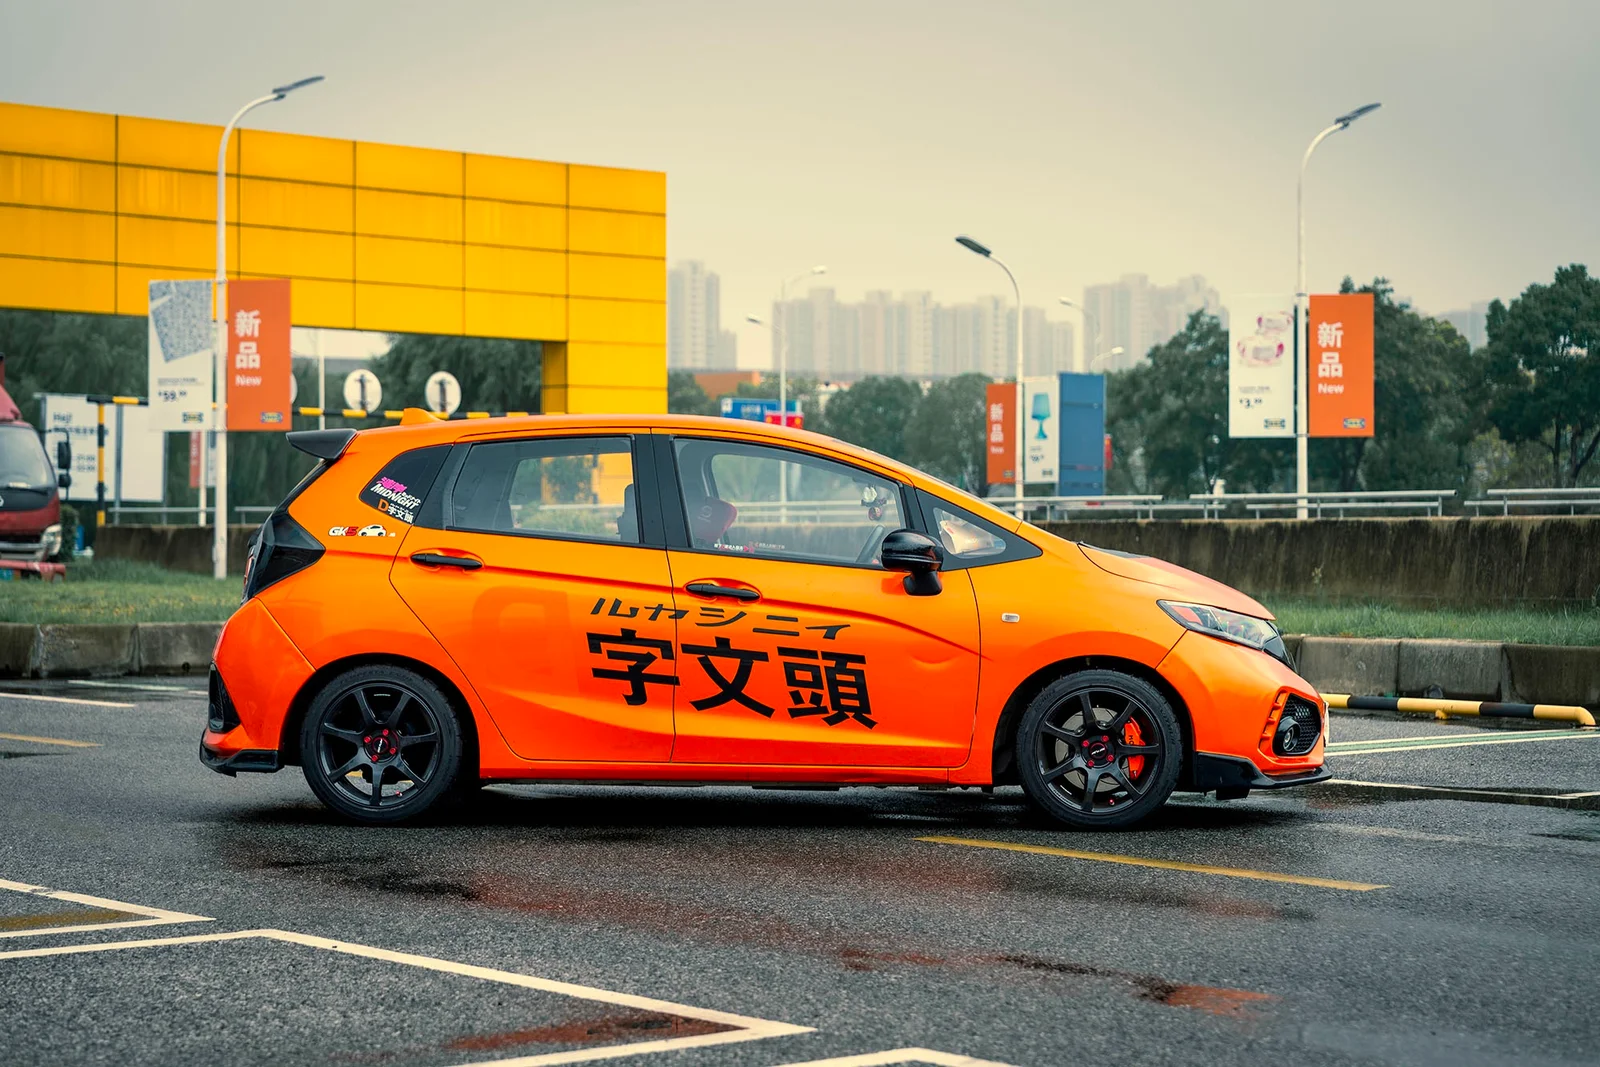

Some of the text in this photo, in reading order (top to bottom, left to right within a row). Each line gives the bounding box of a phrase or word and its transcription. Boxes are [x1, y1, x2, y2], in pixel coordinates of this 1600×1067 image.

[235, 309, 261, 369] 新品
[1317, 321, 1344, 378] 新品
[235, 375, 262, 386] New
[1317, 383, 1345, 394] New
[370, 484, 420, 509] MIDNIGHT
[328, 526, 359, 536] GK5
